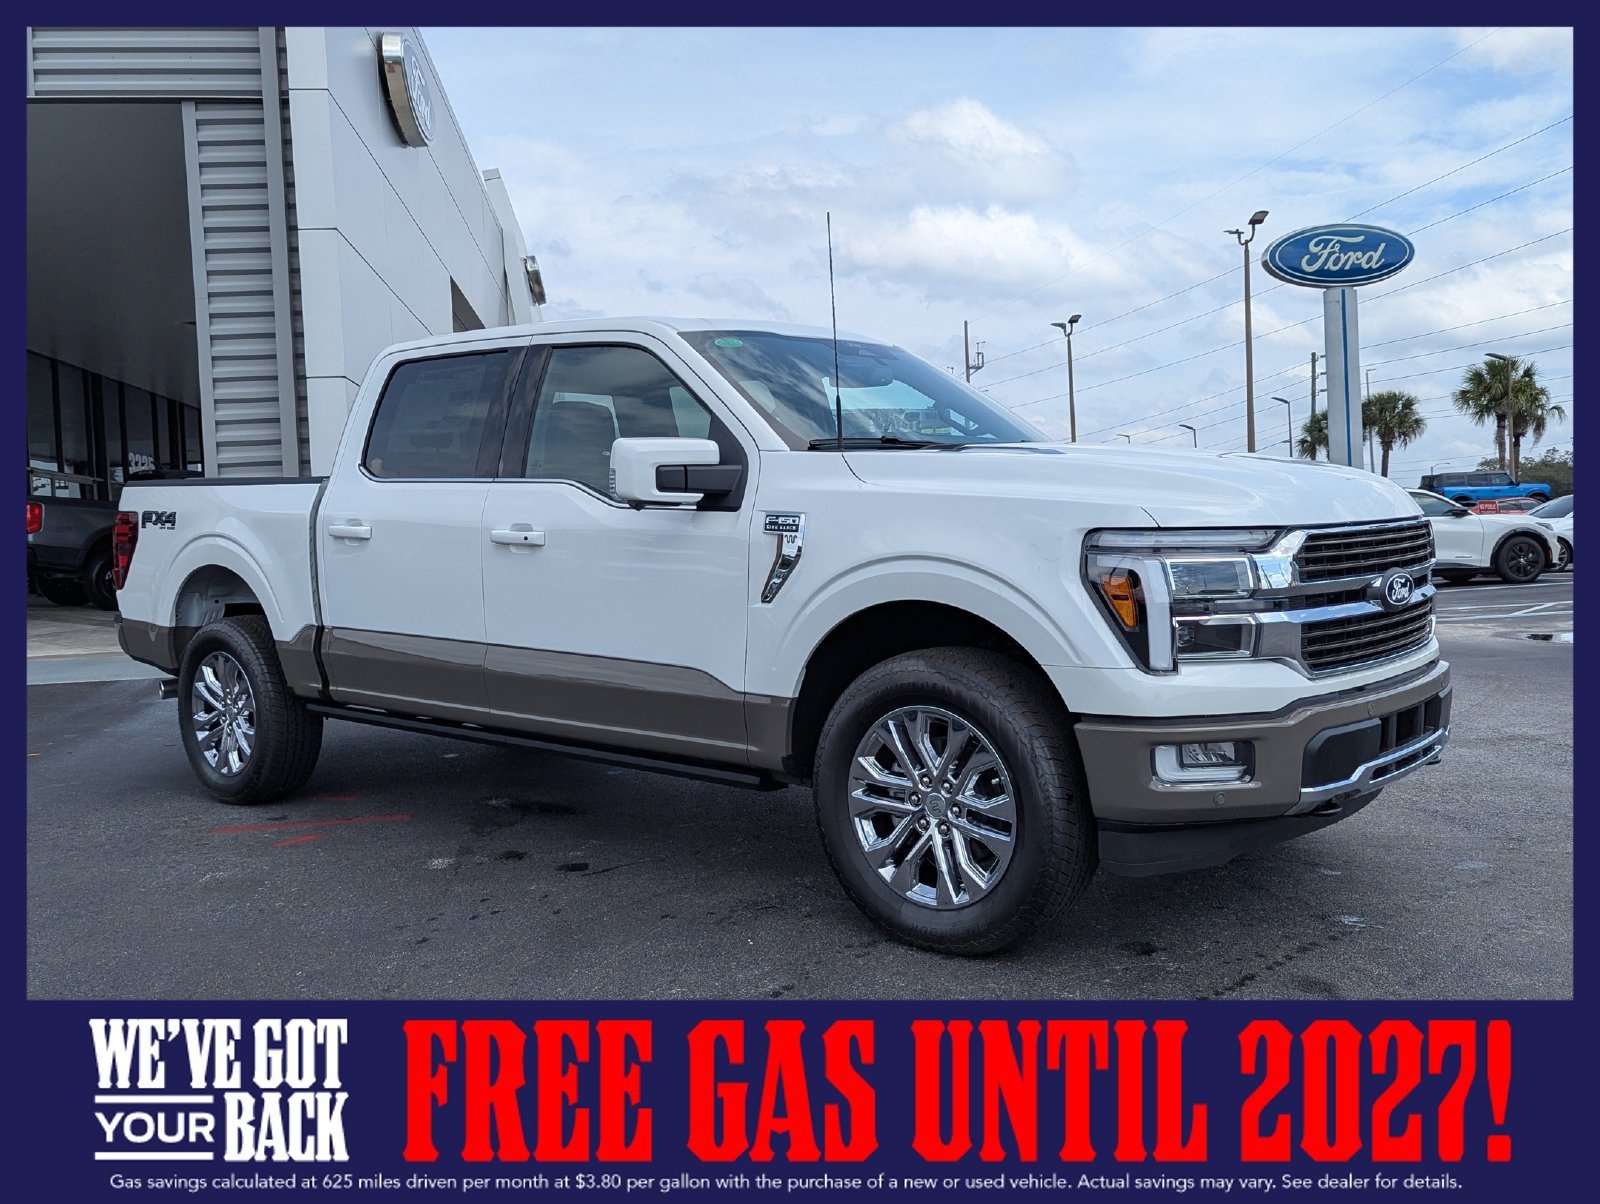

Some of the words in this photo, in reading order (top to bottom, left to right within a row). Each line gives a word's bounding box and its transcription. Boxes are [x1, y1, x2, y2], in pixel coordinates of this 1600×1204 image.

[410, 55, 432, 132] Ford
[1301, 235, 1387, 273] Ford
[141, 511, 177, 529] FX4
[1391, 577, 1410, 601] Ford
